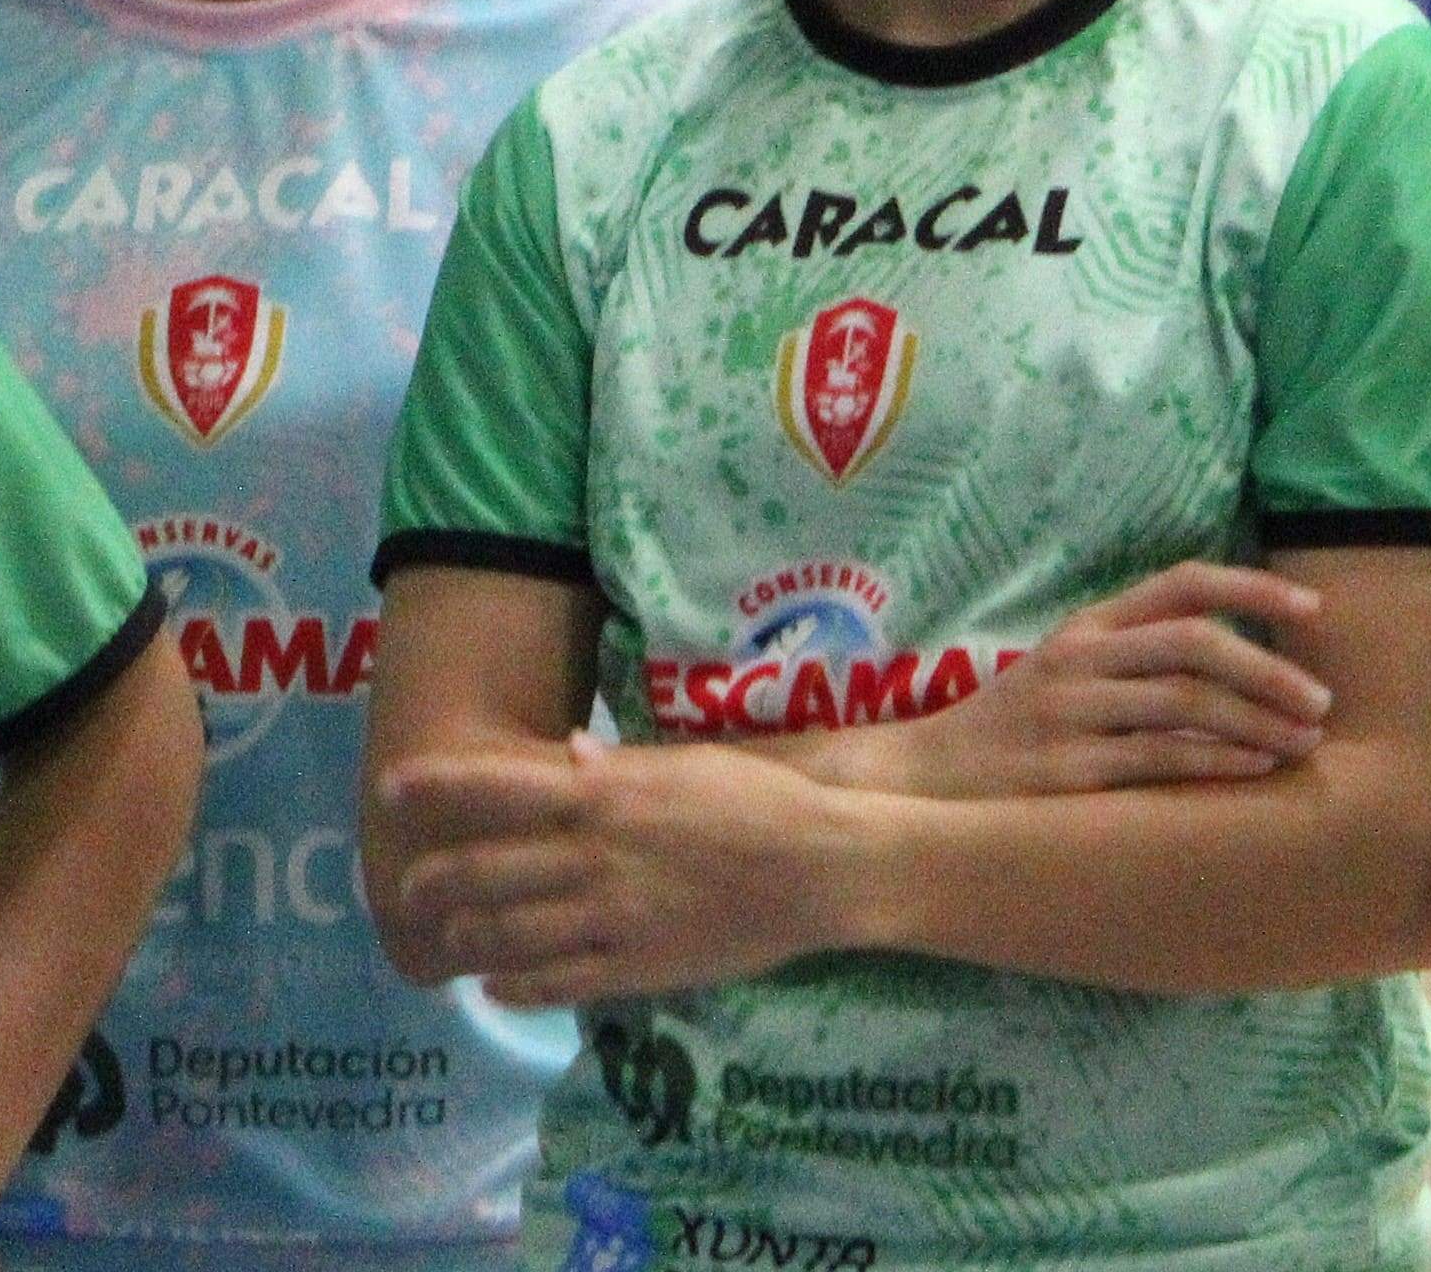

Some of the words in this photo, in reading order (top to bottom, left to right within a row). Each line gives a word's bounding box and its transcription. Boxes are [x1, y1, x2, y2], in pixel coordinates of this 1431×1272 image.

[14, 158, 438, 231] CARACAL
[683, 186, 1082, 258] CARACAL
[138, 519, 277, 573] NSERVAS
[645, 646, 1034, 734] ESCAMA
[148, 1036, 447, 1090] Deputación
[716, 1059, 1020, 1118] Deputación
[150, 1086, 447, 1130] Pontevedra
